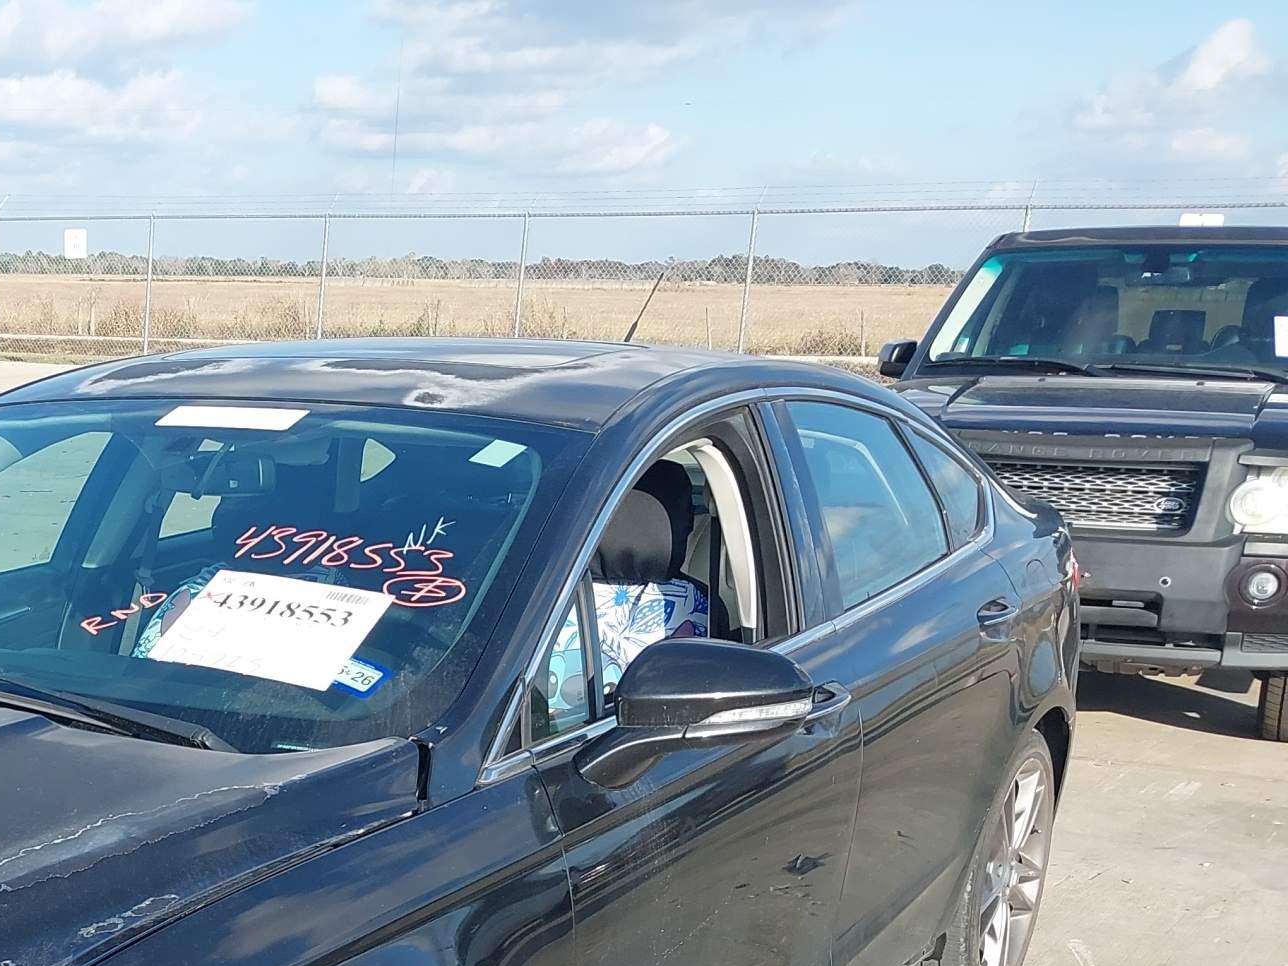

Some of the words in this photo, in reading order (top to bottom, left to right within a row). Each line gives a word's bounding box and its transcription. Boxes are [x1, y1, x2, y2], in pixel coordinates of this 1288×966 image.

[968, 440, 1068, 456] RANGE
[1088, 447, 1194, 461] ROVER
[234, 525, 454, 575] 43918553
[212, 593, 353, 628] 43918553
